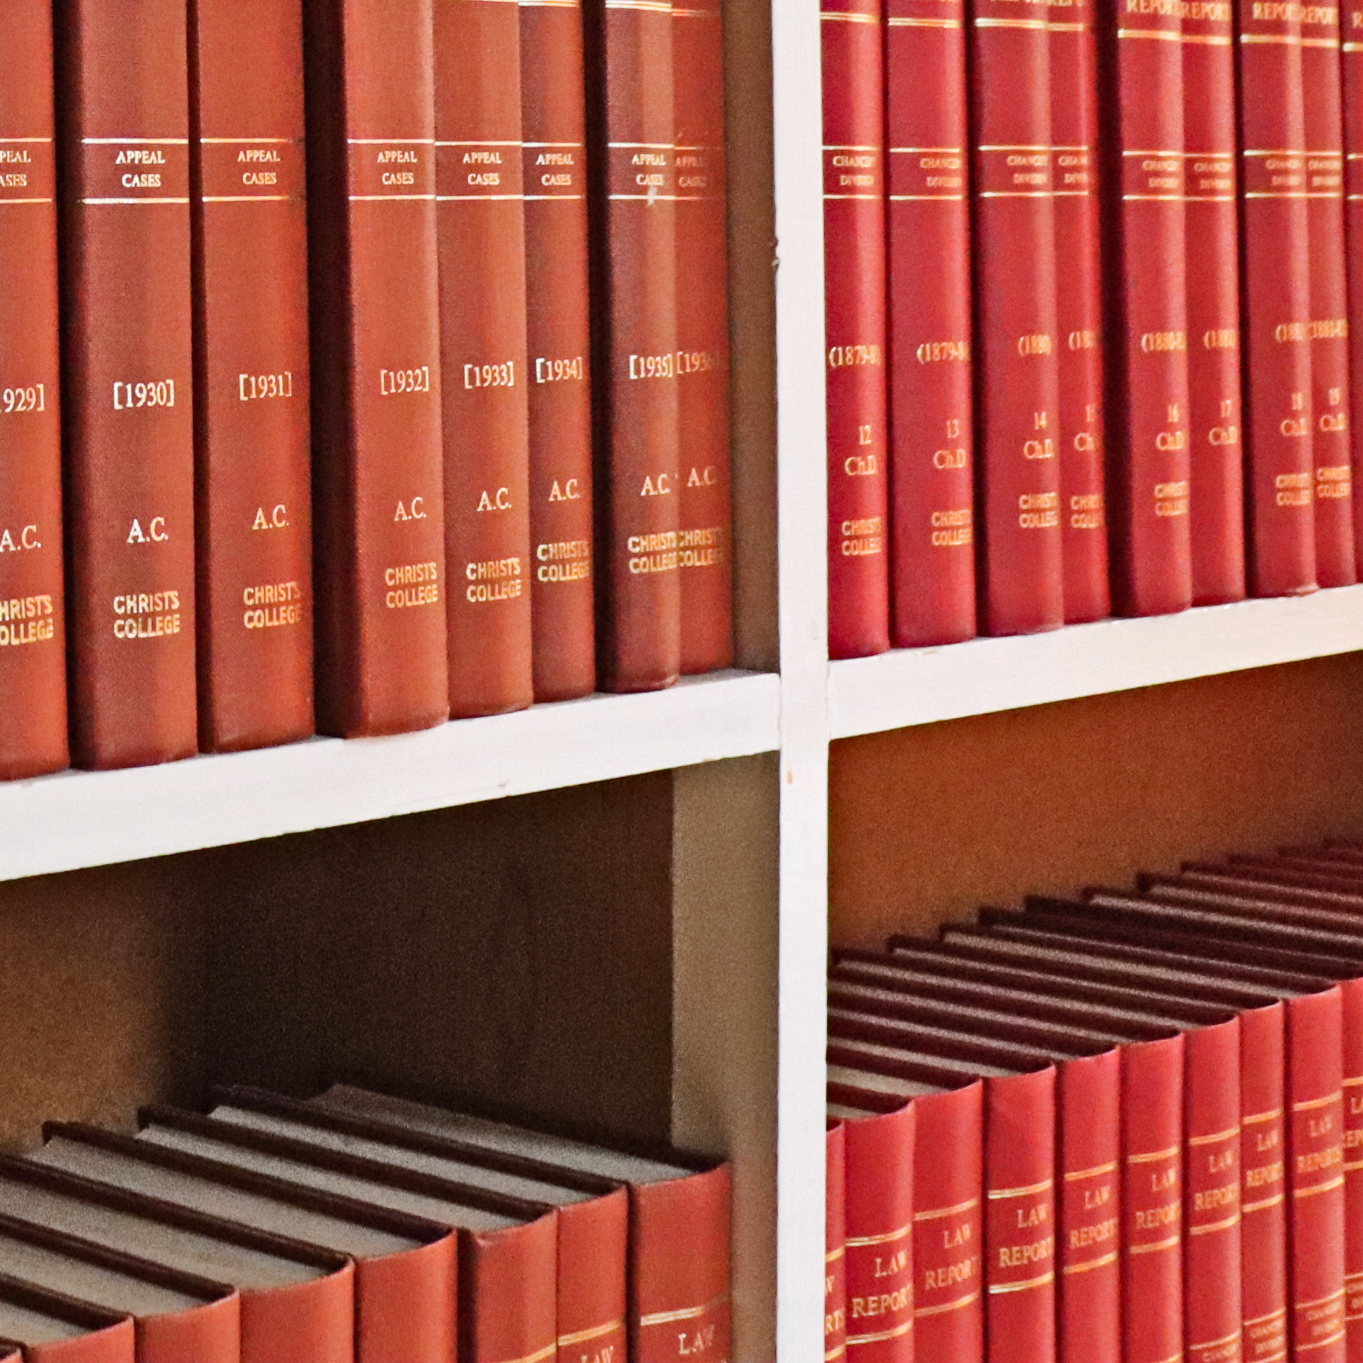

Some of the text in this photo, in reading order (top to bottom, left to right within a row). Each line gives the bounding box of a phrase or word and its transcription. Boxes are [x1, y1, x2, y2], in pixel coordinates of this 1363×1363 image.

[115, 150, 166, 165] APPEAL
[377, 150, 418, 164] APPEAL
[536, 153, 574, 166] APPEAL
[121, 173, 161, 188] CASES
[381, 172, 415, 185] CASES
[541, 173, 572, 186] CASES
[463, 360, 515, 389] [1933]
[535, 356, 583, 384] [1934]
[629, 354, 674, 380] [1935]
[239, 371, 292, 401] [1931]
[380, 366, 430, 396] [1932]
[113, 379, 175, 410] [1930]
[476, 487, 513, 512] A.C.
[548, 478, 581, 502] A.C.
[251, 504, 290, 531] A.C.
[393, 497, 427, 522] A.C.
[126, 516, 169, 544] A.C.
[385, 583, 439, 609] COLLEGE
[466, 578, 522, 603] COLLEGE
[113, 613, 181, 639] COLLEGE
